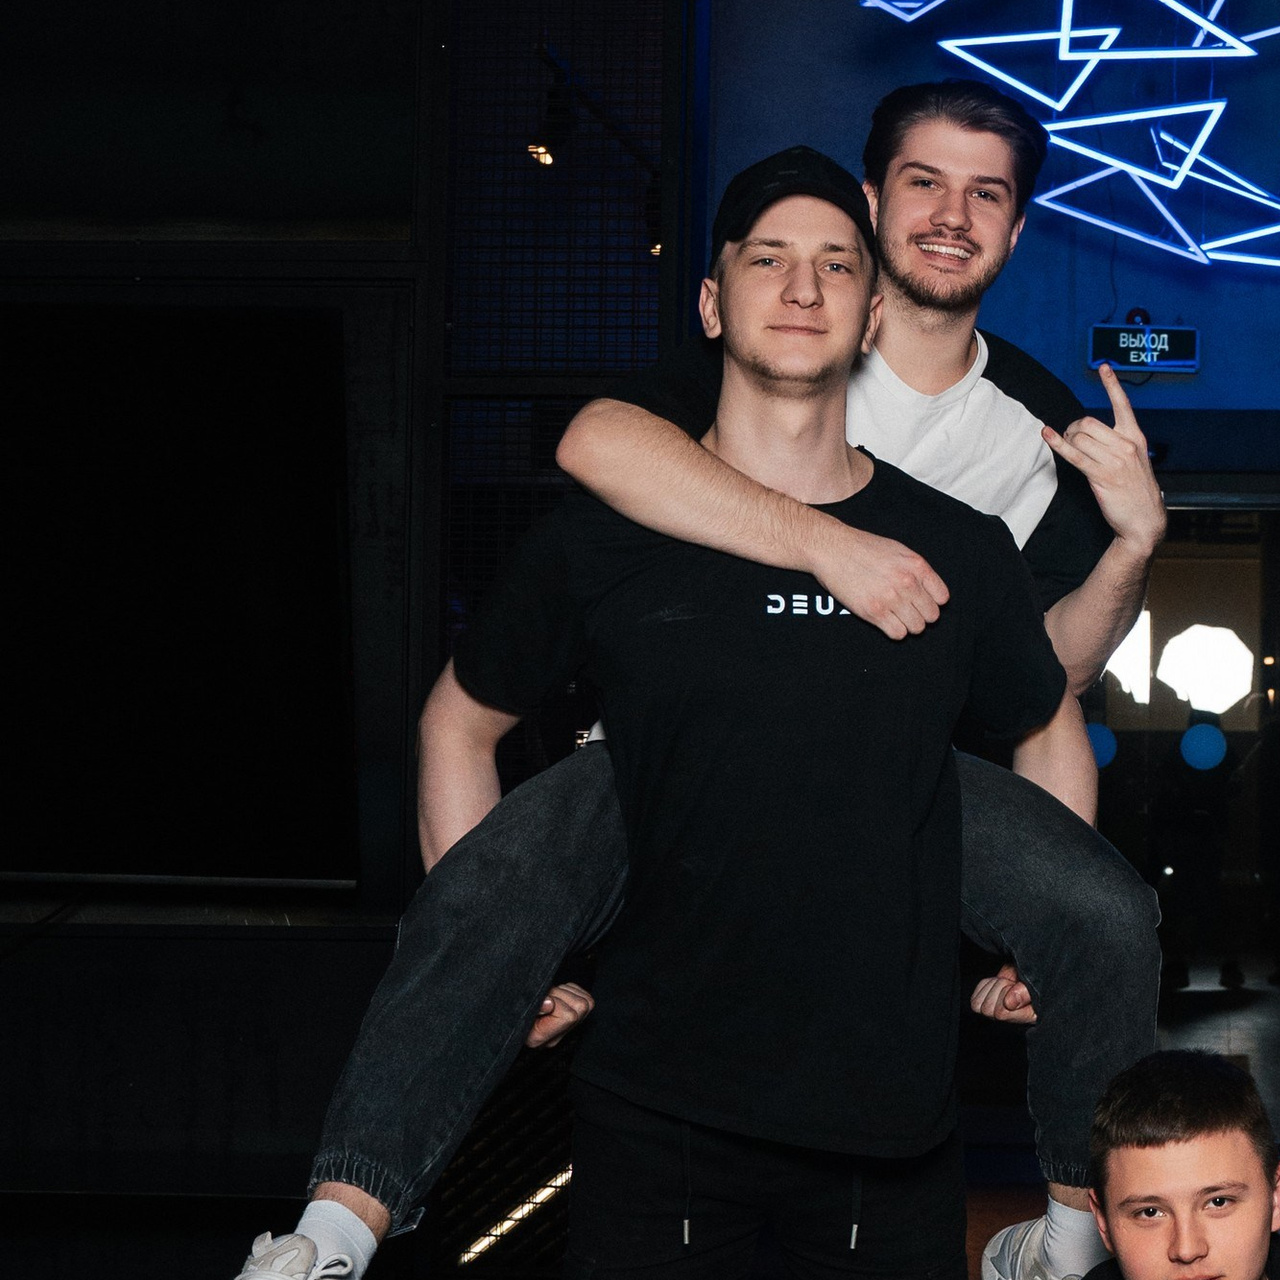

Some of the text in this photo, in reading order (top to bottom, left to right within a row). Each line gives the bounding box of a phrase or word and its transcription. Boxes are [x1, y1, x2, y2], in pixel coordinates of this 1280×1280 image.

[1119, 333, 1169, 351] ВЫХОД
[1130, 351, 1159, 362] EXIT
[767, 594, 851, 615] DEU
